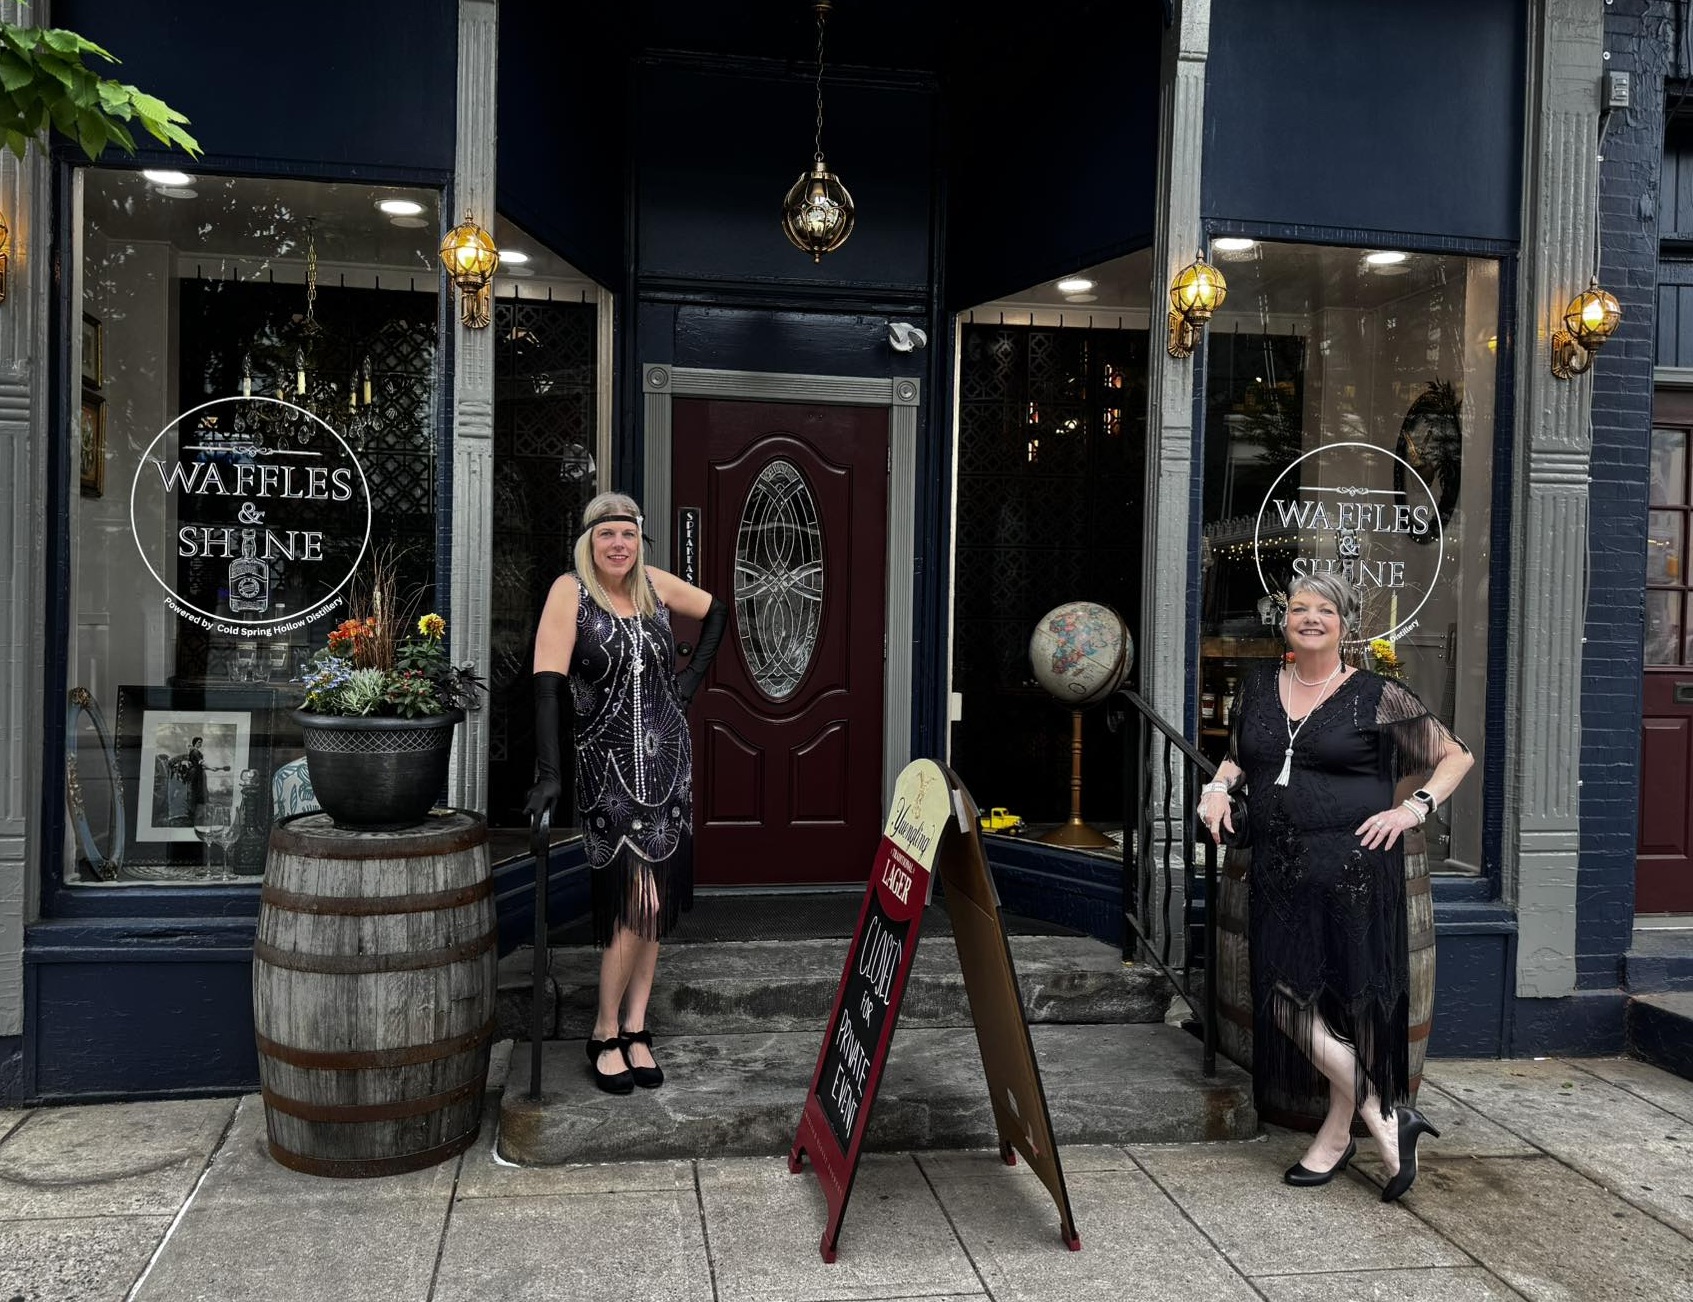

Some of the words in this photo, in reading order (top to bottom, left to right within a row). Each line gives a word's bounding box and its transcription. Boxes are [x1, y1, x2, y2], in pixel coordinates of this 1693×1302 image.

[151, 459, 353, 501] WAFFLES
[237, 501, 266, 525] &
[1273, 499, 1430, 535] WAFFLES
[1339, 535, 1361, 556] &
[164, 596, 202, 625] Powered
[201, 618, 214, 631] by
[217, 623, 240, 635] Cold
[240, 627, 273, 638] Spring
[273, 618, 306, 635] Hollow
[305, 596, 343, 624] Distillery
[1389, 618, 1420, 644] Distillery
[889, 796, 936, 862] Yuengling
[881, 858, 913, 906] LAGER
[859, 915, 902, 1006] CLOSED
[860, 990, 874, 1028] FOR
[835, 1008, 871, 1098] PRIVATE
[831, 1062, 859, 1139] EVENT
